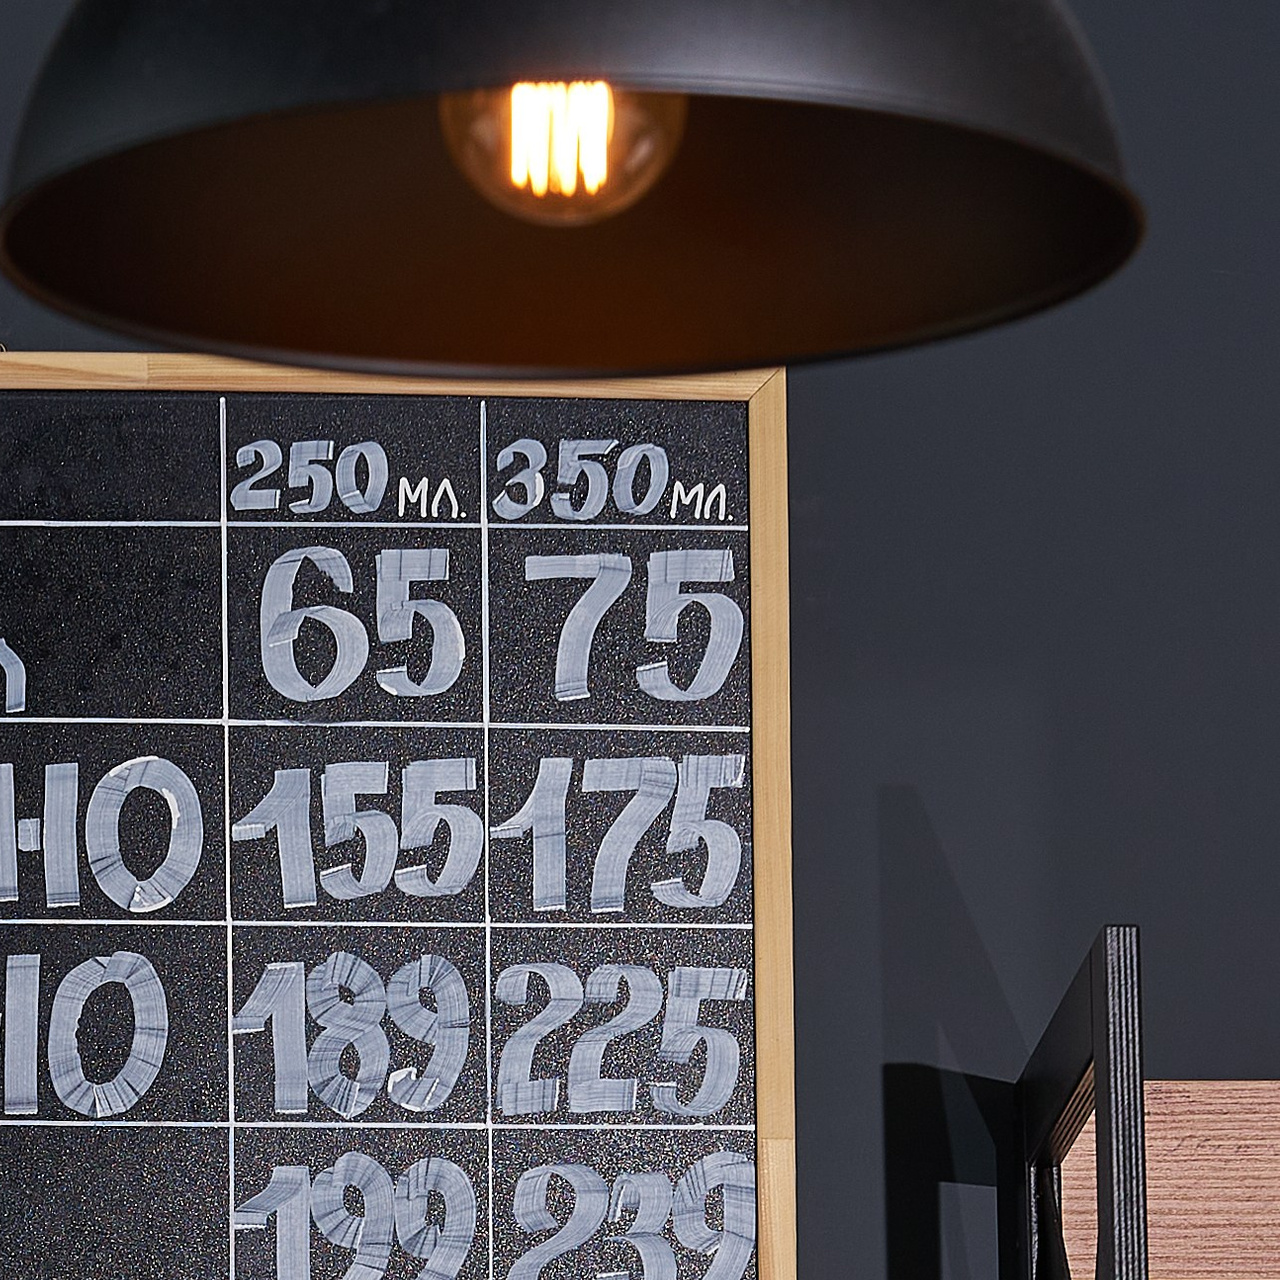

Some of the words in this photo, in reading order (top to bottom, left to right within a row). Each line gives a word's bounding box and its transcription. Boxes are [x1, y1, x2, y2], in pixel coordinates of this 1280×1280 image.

[230, 440, 389, 514] 250
[493, 438, 669, 520] 350
[260, 546, 465, 702] 65
[525, 549, 745, 701] 75
[231, 758, 483, 909] 155
[490, 754, 746, 912] 175
[232, 951, 470, 1118] 189
[495, 962, 747, 1117] 225
